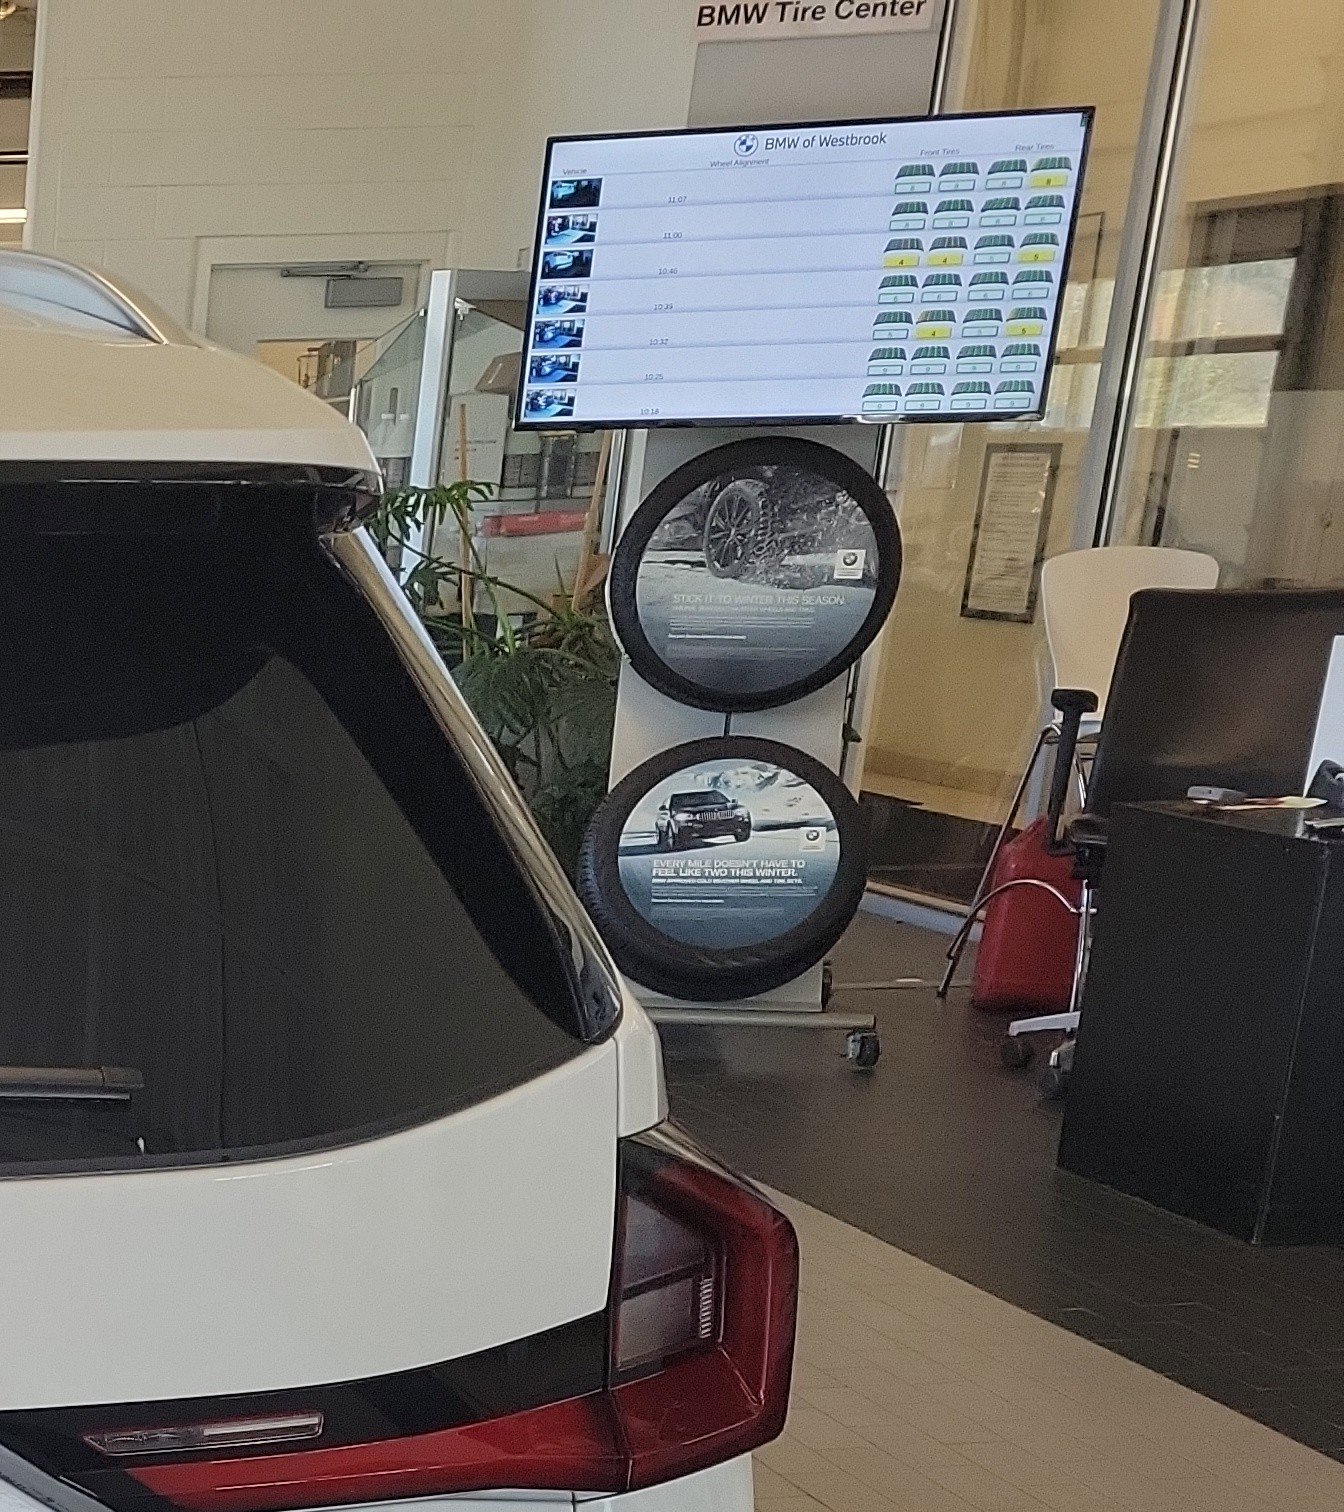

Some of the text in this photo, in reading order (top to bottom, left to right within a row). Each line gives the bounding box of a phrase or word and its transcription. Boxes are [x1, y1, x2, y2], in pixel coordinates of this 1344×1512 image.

[697, 0, 927, 28] BMW Tire Center
[765, 132, 887, 150] BMW of Westbrook
[653, 859, 686, 868] EVERY
[761, 859, 789, 868] HAVE
[792, 859, 806, 868] TO
[652, 868, 678, 877] FEEL
[679, 868, 702, 877] LIKE
[704, 868, 728, 876] TWO
[731, 868, 754, 876] THIS
